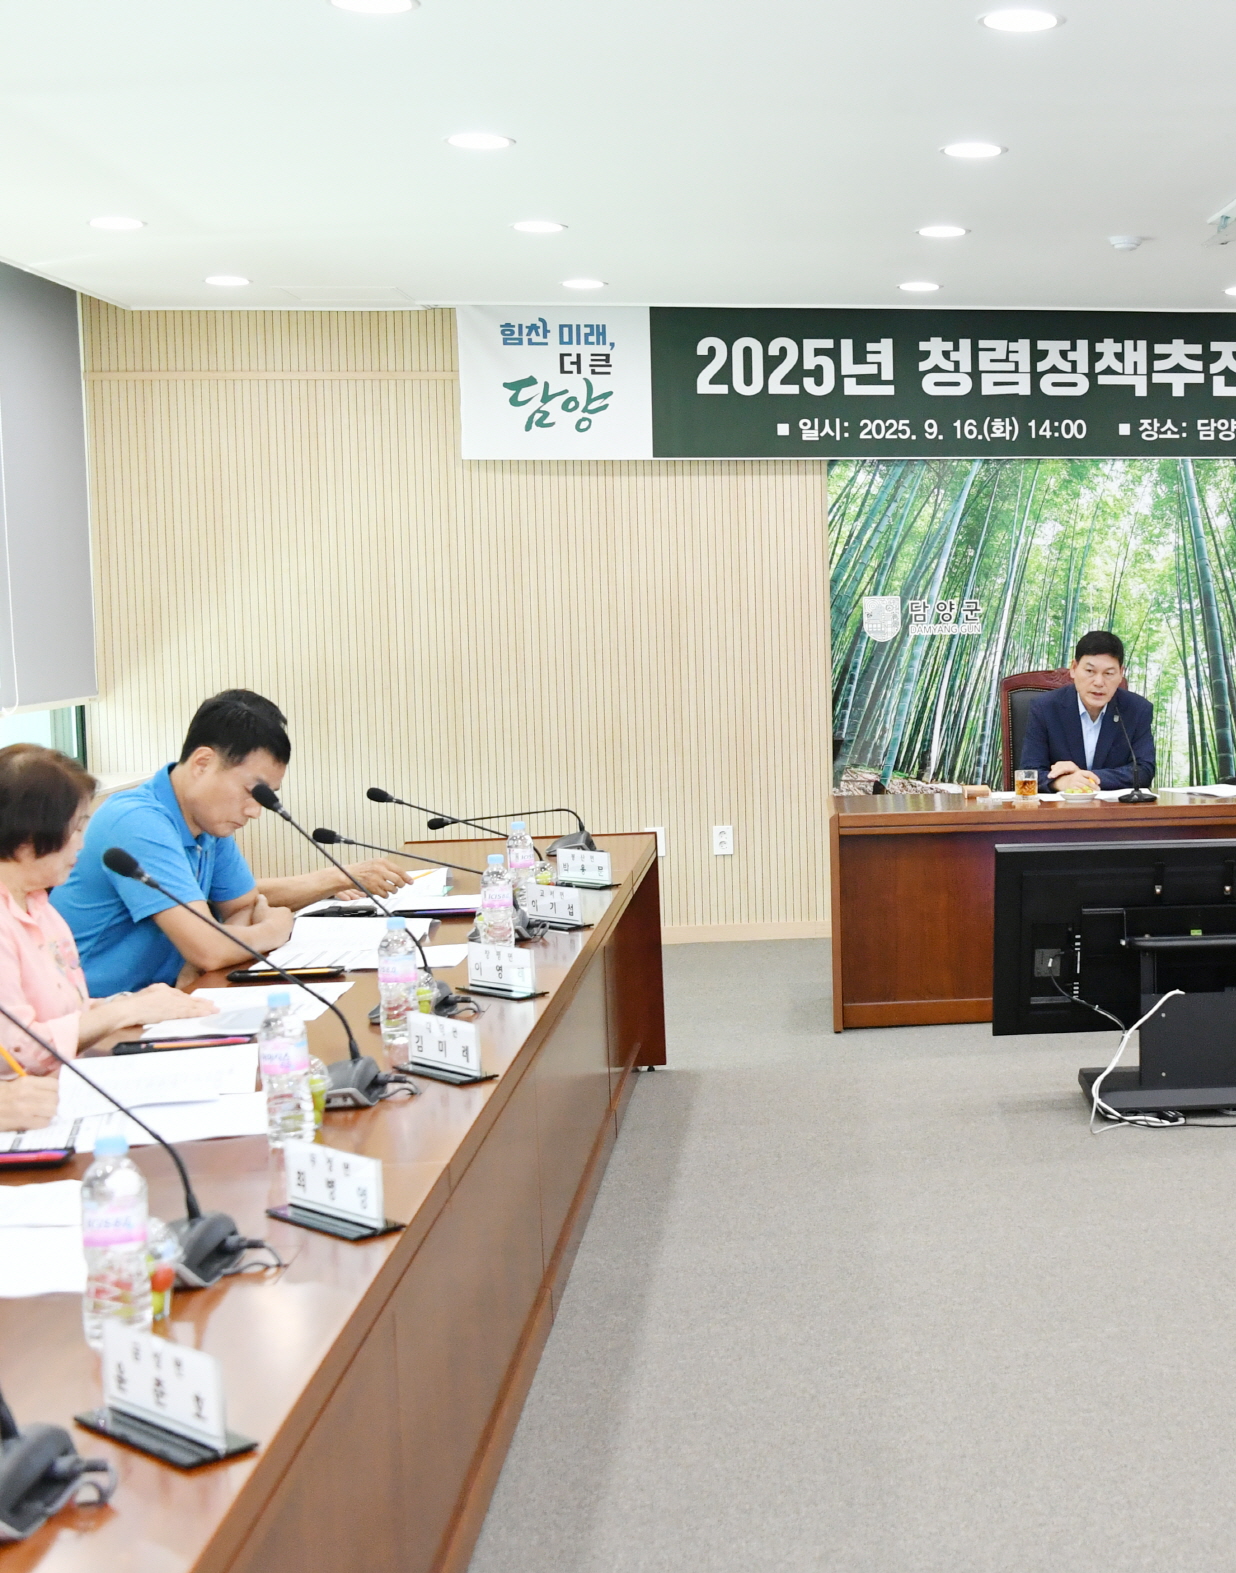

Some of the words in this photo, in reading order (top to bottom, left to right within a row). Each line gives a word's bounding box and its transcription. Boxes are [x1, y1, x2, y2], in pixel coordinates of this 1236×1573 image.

[500, 317, 551, 346] 힘찬
[559, 323, 615, 351] 미래,
[559, 353, 581, 375] 더
[589, 353, 612, 375] 큰
[696, 336, 895, 397] 2025년
[502, 375, 614, 433] 담양
[798, 417, 850, 441] 일시:
[859, 418, 917, 441] 2025.
[923, 418, 944, 441] 9.
[952, 416, 1019, 442] 16.(화)
[1027, 419, 1087, 441] 14:00
[1138, 417, 1187, 441] 장소:
[909, 600, 981, 622] 담양군
[909, 624, 958, 635] DAMYANG
[960, 624, 982, 635] GUN
